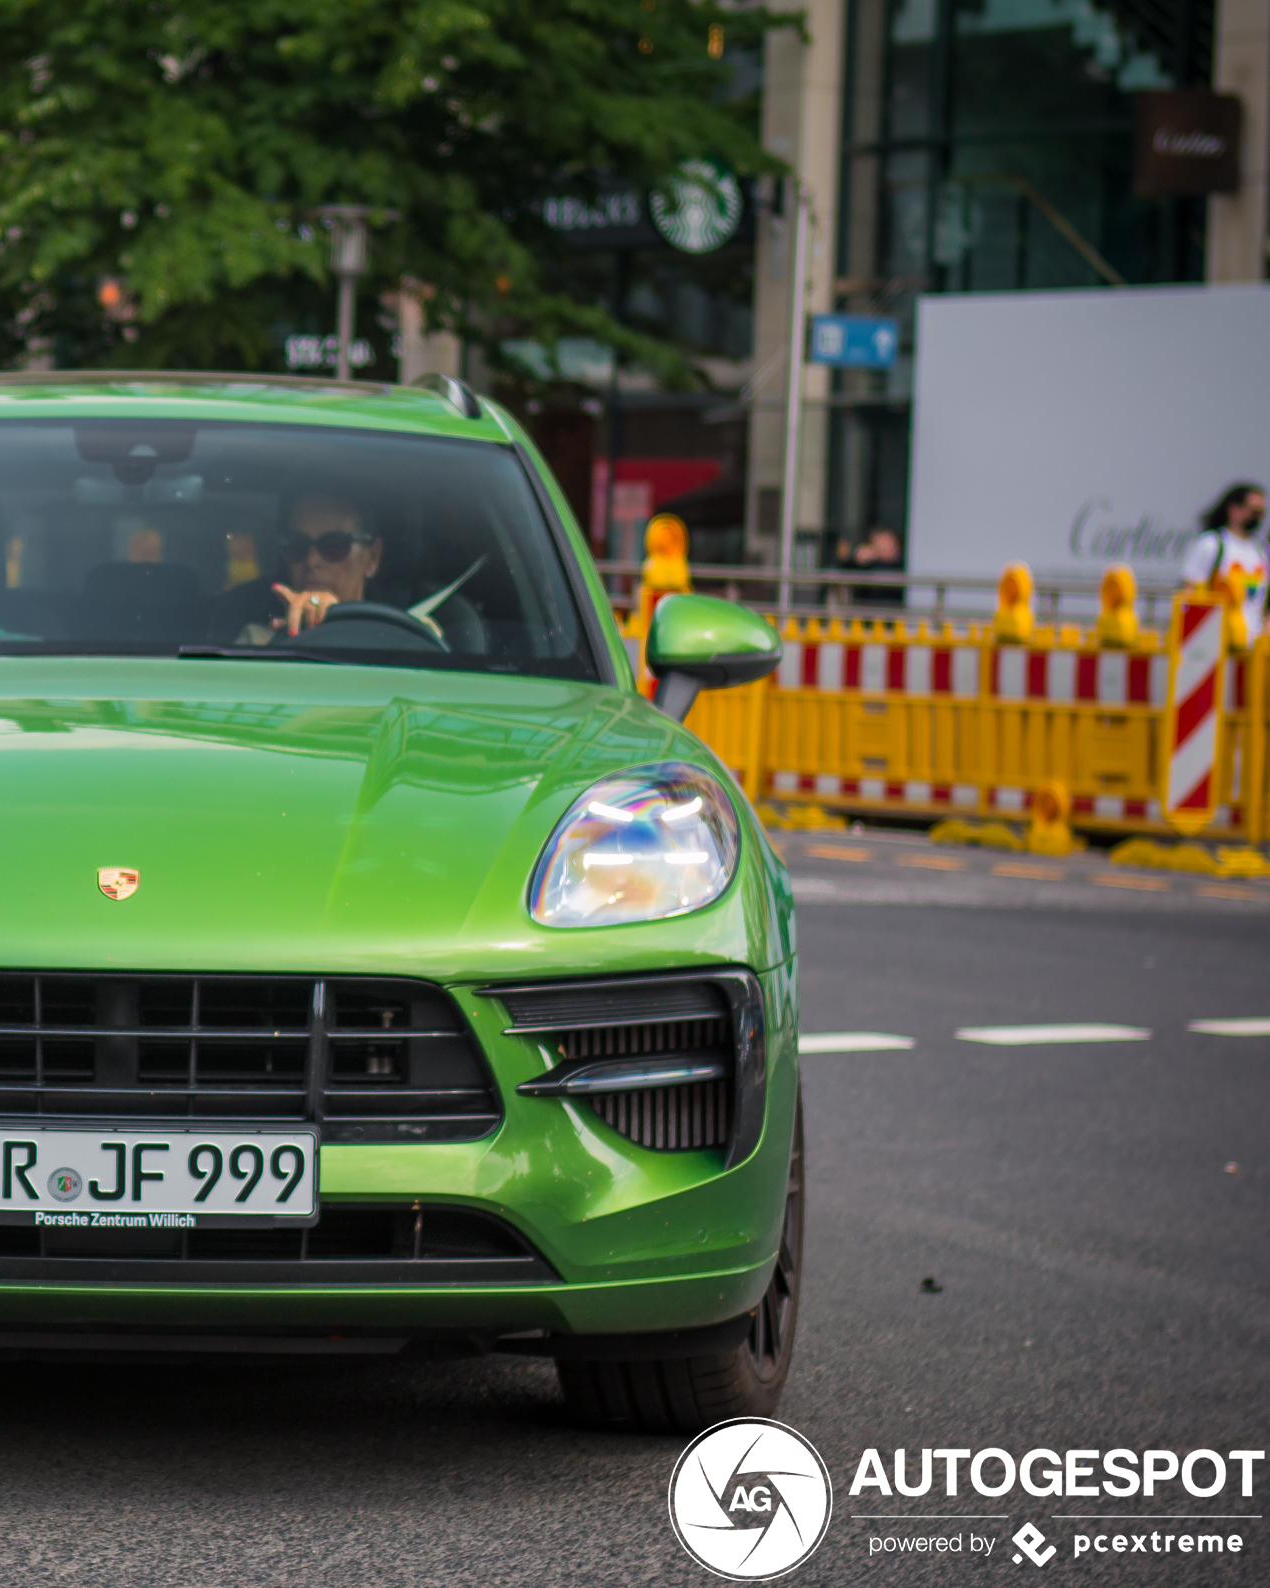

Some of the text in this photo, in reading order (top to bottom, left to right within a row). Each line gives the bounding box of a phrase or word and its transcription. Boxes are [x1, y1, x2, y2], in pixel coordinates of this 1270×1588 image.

[88, 1142, 170, 1201] JF
[187, 1143, 305, 1202] 999
[34, 1211, 196, 1228] Porsche Zentrum Willich
